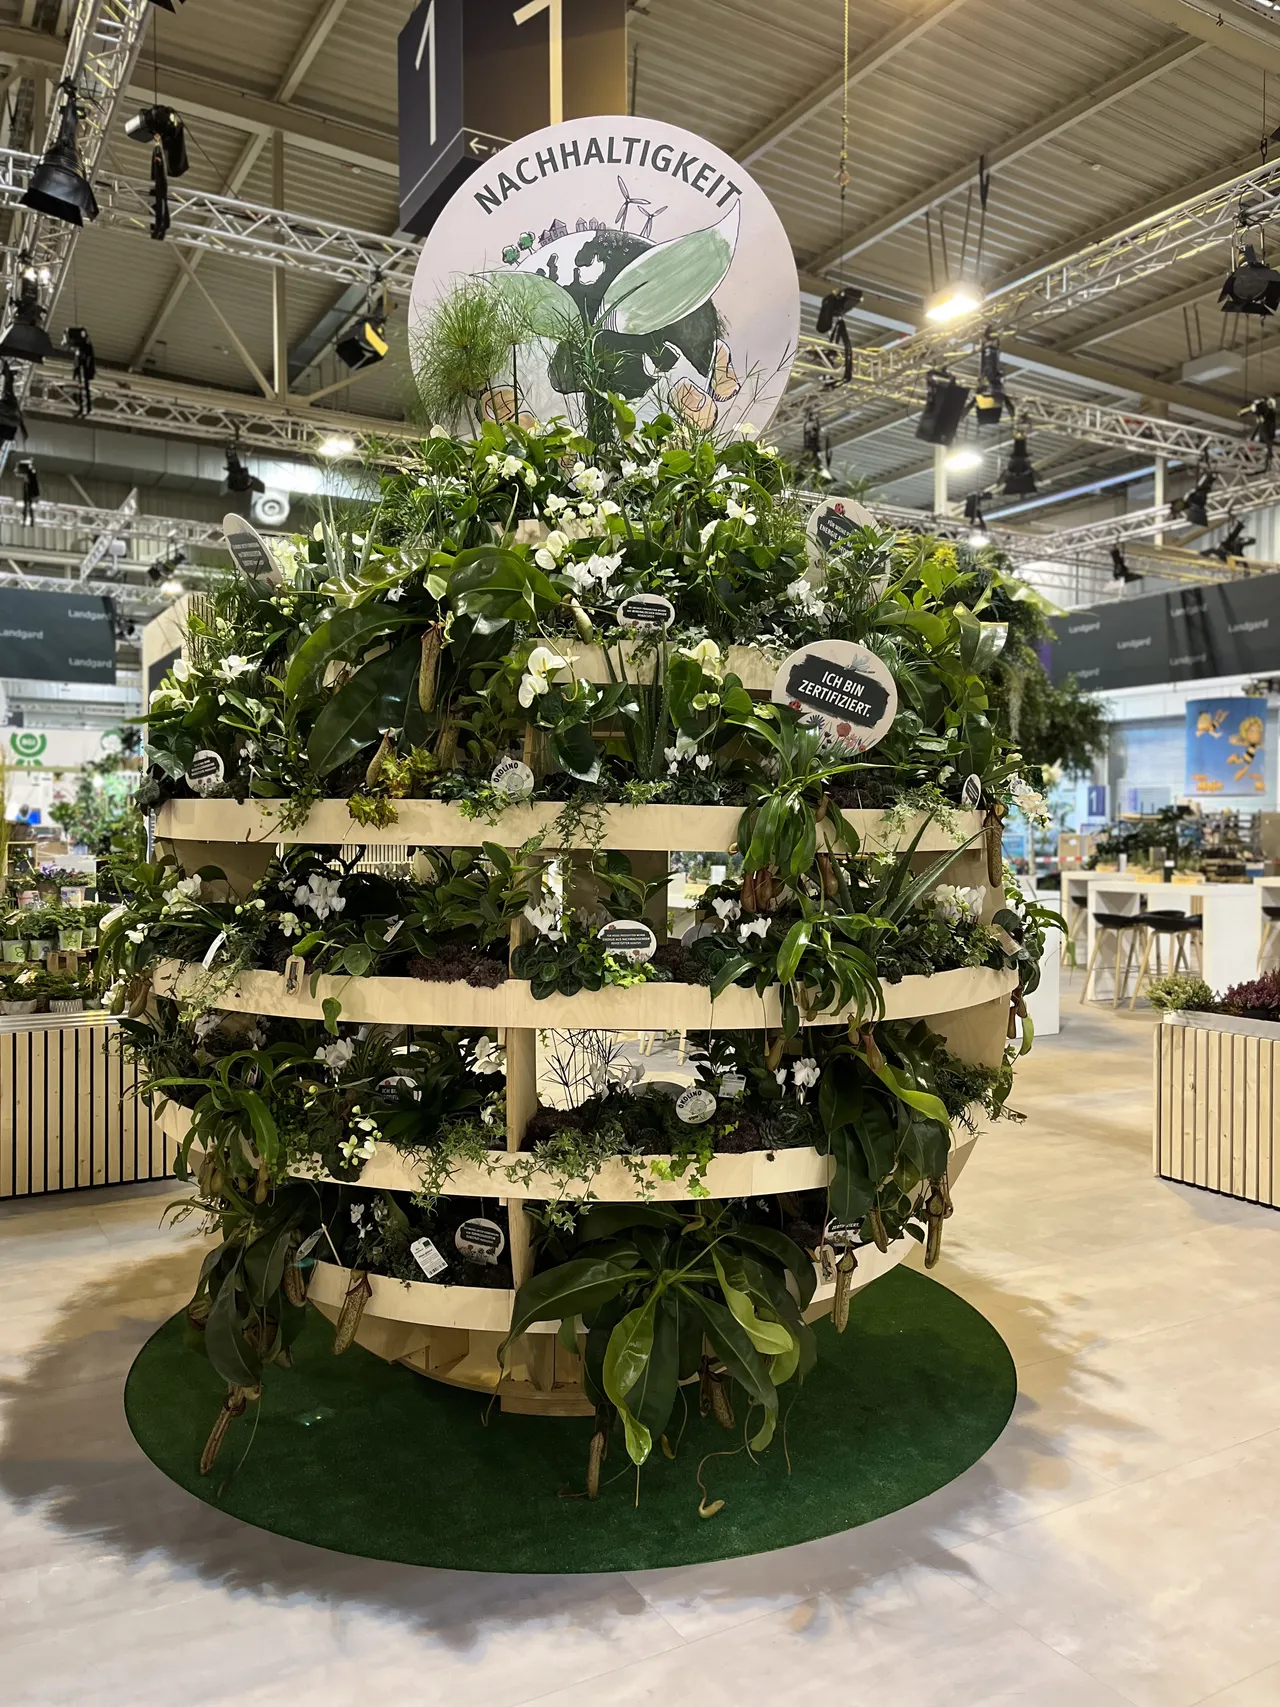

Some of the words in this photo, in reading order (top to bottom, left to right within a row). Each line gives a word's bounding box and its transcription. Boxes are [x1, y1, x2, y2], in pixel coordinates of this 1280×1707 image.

[415, 0, 437, 146] 1
[513, 0, 563, 126] 1
[473, 136, 743, 215] NACHHALTIGKEIT
[819, 524, 838, 540] ENERGIE
[1068, 621, 1100, 634] Landgard
[1227, 617, 1269, 633] Landgard
[1116, 636, 1151, 650] Landgard
[69, 657, 112, 668] Landgard
[821, 671, 843, 689] ICH
[843, 679, 865, 697] BIN
[797, 679, 872, 718] ZERTIFIZIERT.
[1090, 790, 1097, 813] 1
